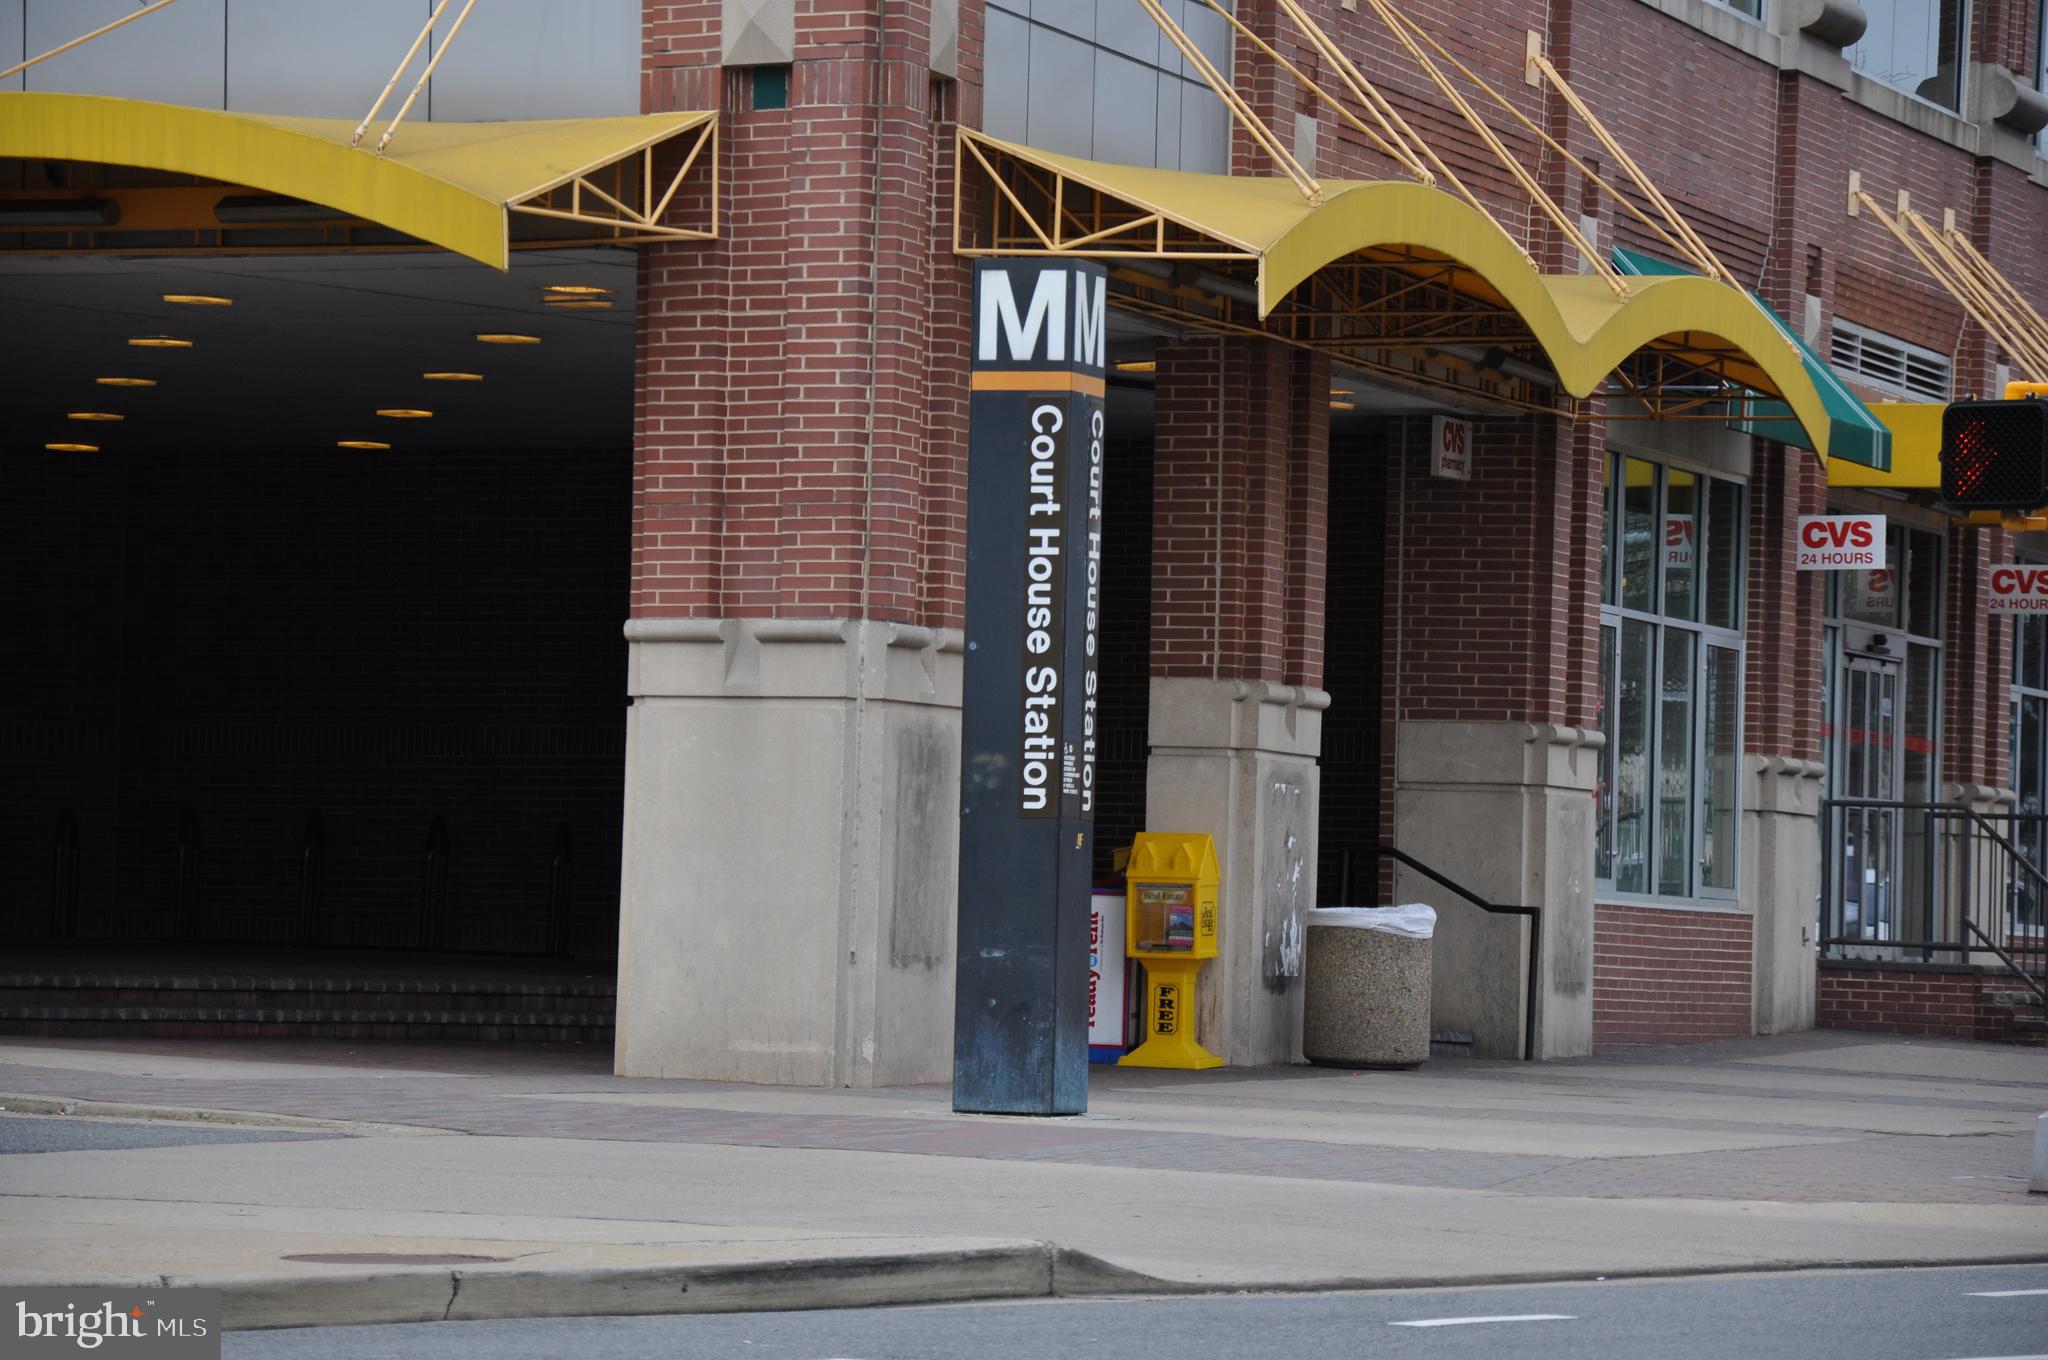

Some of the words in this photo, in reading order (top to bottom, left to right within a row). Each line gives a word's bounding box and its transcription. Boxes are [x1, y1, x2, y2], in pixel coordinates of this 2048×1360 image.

[978, 269, 1067, 361] M
[1074, 270, 1106, 368] M
[1029, 404, 1063, 516] Court
[1088, 409, 1104, 521] Court
[1443, 420, 1465, 455] CVS
[1801, 520, 1873, 549] CVS
[1801, 553, 1817, 565] 24
[1821, 552, 1874, 565] HOURS
[1026, 528, 1060, 655] House
[1085, 531, 1100, 657] House
[1990, 598, 2005, 609] 24
[2009, 598, 2048, 609] HOUR
[1022, 666, 1057, 810] Station
[1081, 669, 1097, 812] Station
[1157, 986, 1176, 1033] FREE
